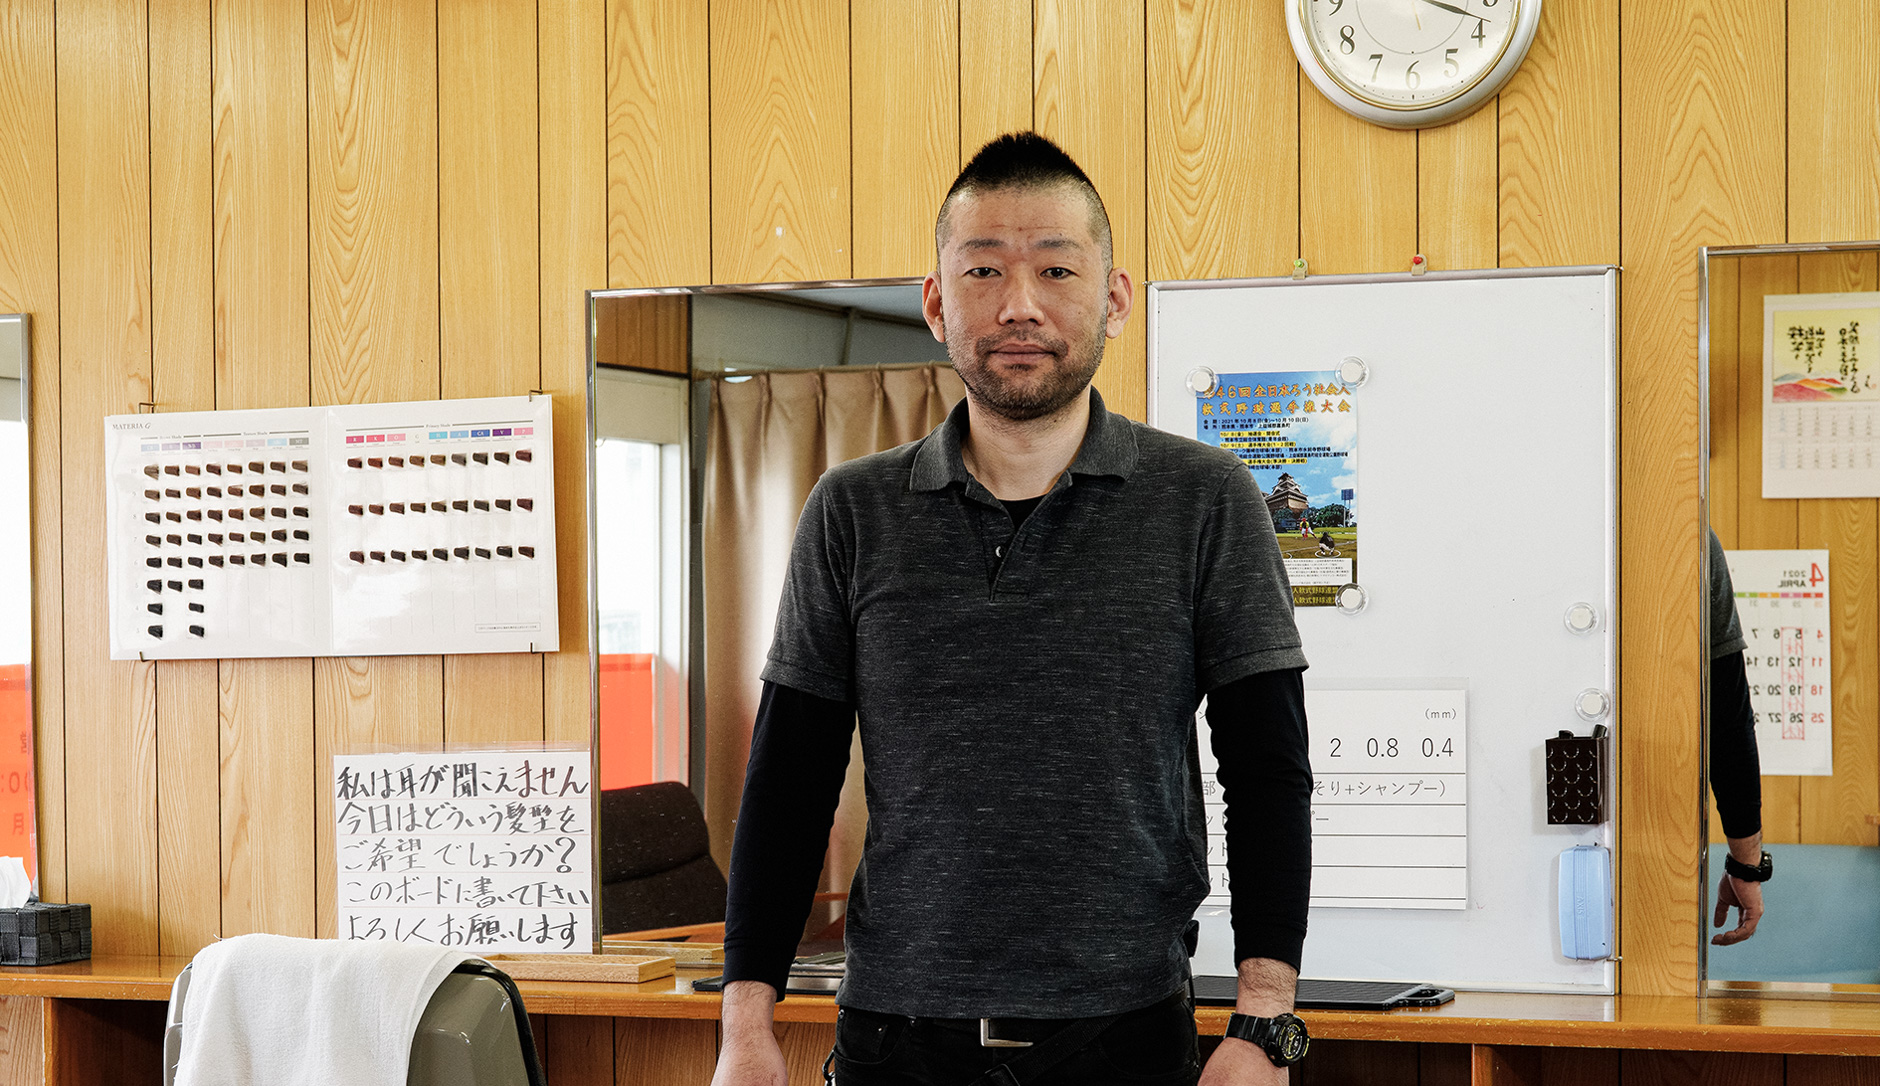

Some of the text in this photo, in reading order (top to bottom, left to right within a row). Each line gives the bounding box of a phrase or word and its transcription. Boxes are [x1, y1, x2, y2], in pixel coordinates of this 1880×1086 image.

[1340, 25, 1355, 55] 8
[1471, 19, 1486, 48] 4
[1369, 54, 1383, 83] 7
[1405, 60, 1421, 90] 6
[1444, 48, 1460, 78] 5
[1203, 383, 1352, 400] 46回全日本ろう社会人
[1201, 399, 1352, 417] 軟式野球選手権大会
[1425, 707, 1457, 721] (mm)
[1330, 737, 1454, 758] 2 0.8 0.4
[337, 759, 589, 800] 私は耳が聞こえません
[338, 800, 584, 836] 今日はどういう髪型を
[344, 836, 577, 874] ご希望でしょうか?
[346, 875, 590, 909] このボードに書いて下さい
[347, 911, 579, 950] よろしくお願いします
